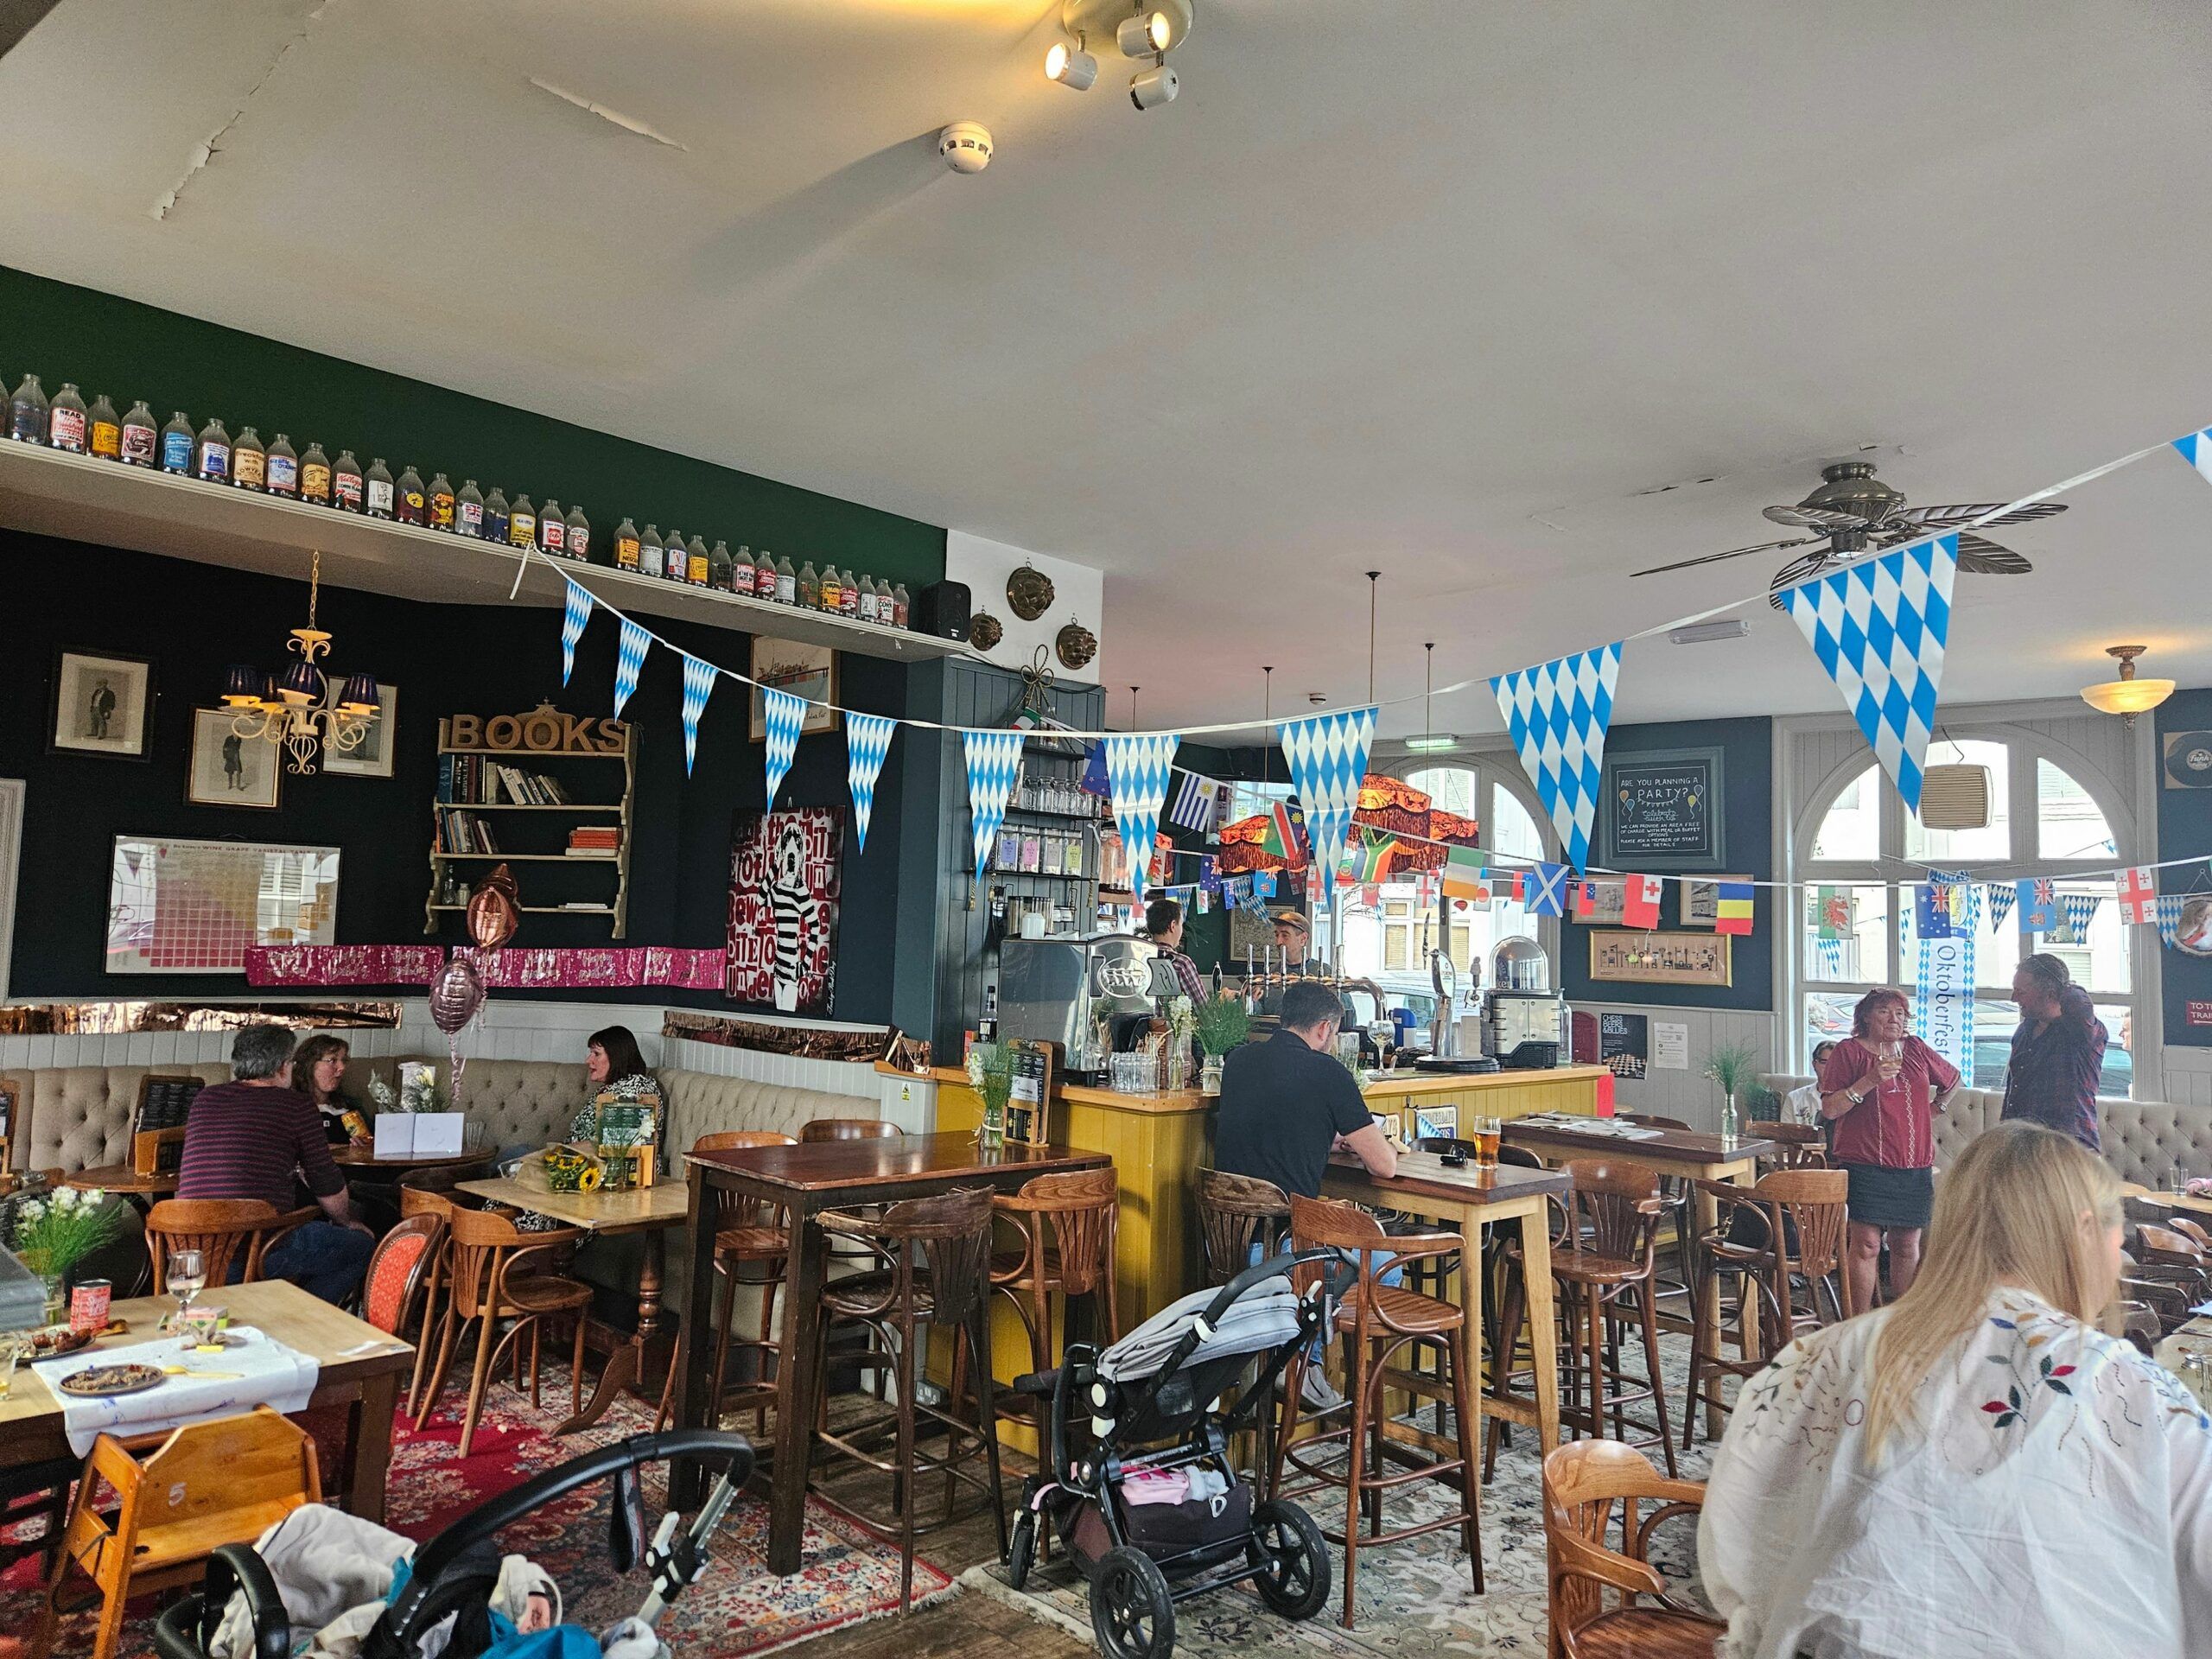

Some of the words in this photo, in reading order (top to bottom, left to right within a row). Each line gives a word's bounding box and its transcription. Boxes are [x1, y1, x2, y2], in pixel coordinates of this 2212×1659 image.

[450, 714, 626, 753] BOOKS
[1637, 787, 1688, 799] PARTY?
[1935, 945, 1956, 1057] Oktoberfest
[168, 1482, 187, 1506] 5
